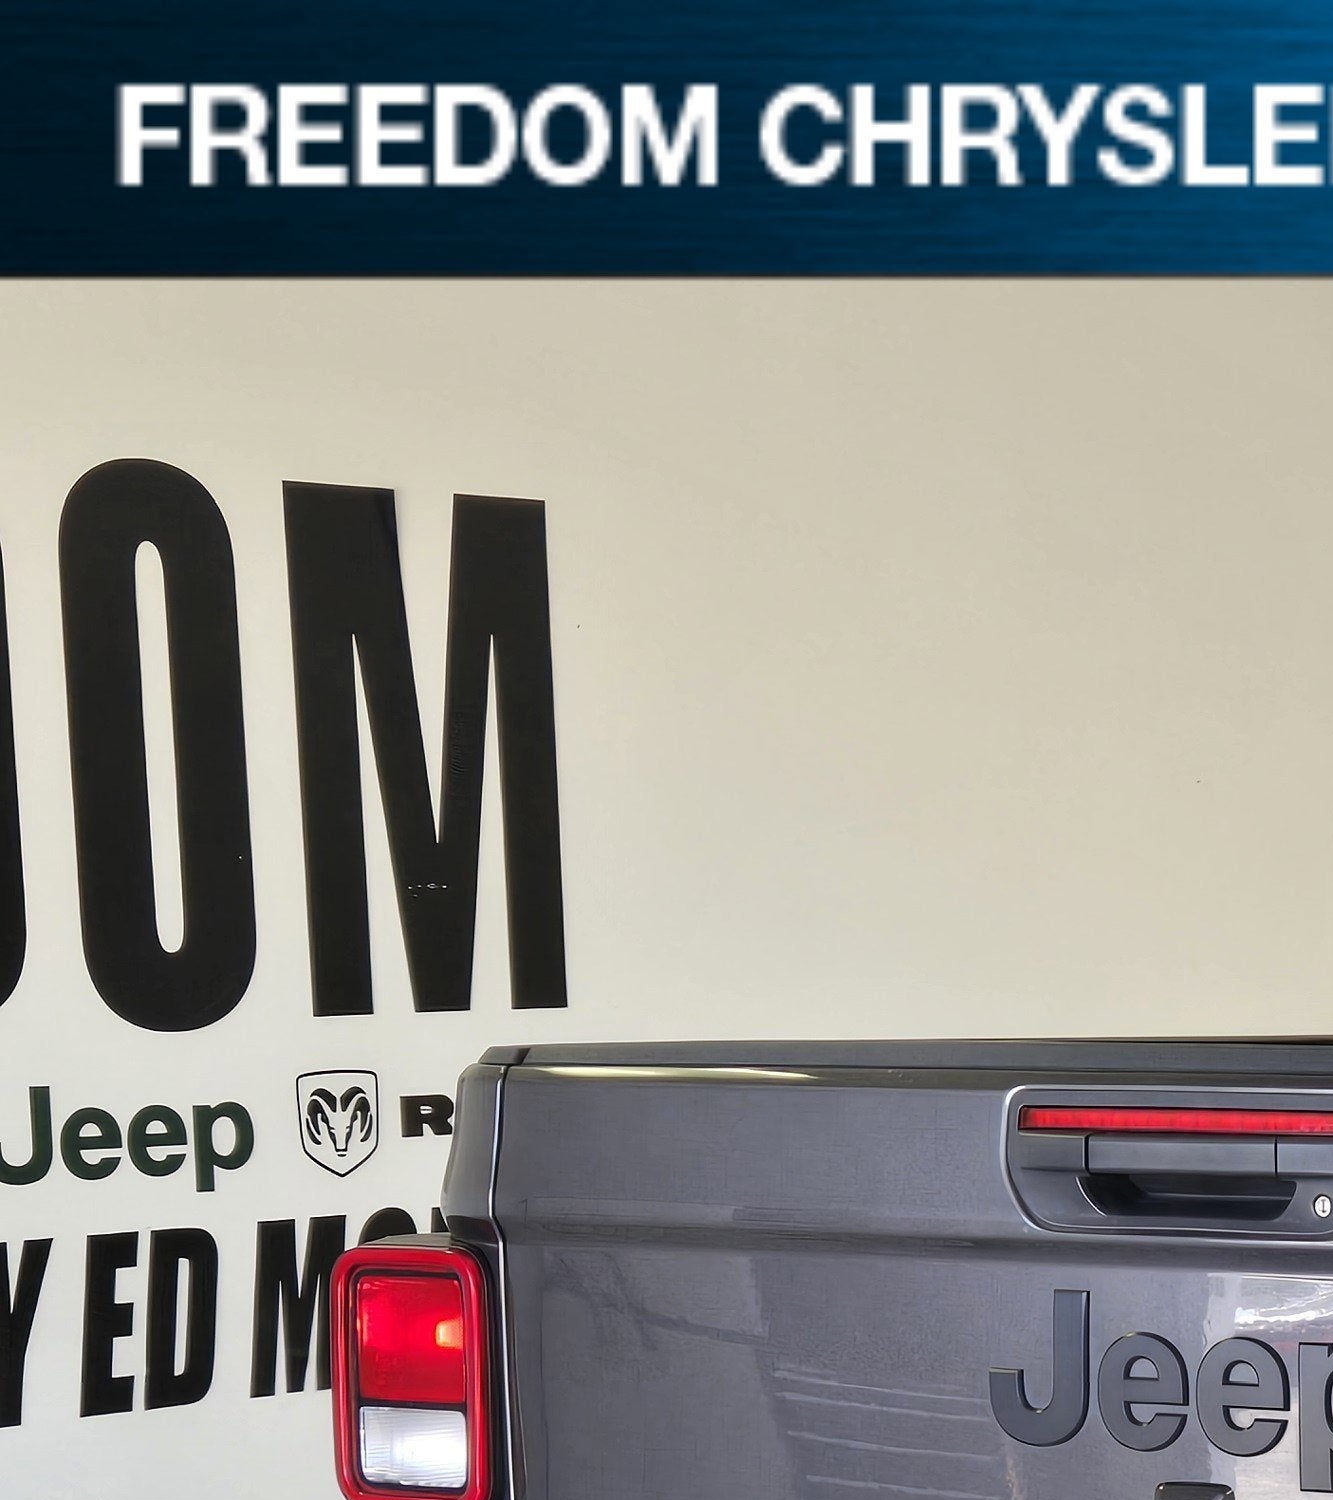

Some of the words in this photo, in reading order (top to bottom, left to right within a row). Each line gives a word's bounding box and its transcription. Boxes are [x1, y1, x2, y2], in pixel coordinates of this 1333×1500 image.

[0, 459, 567, 1032] OM
[0, 1086, 254, 1192] Jeep
[81, 1228, 218, 1417] ED
